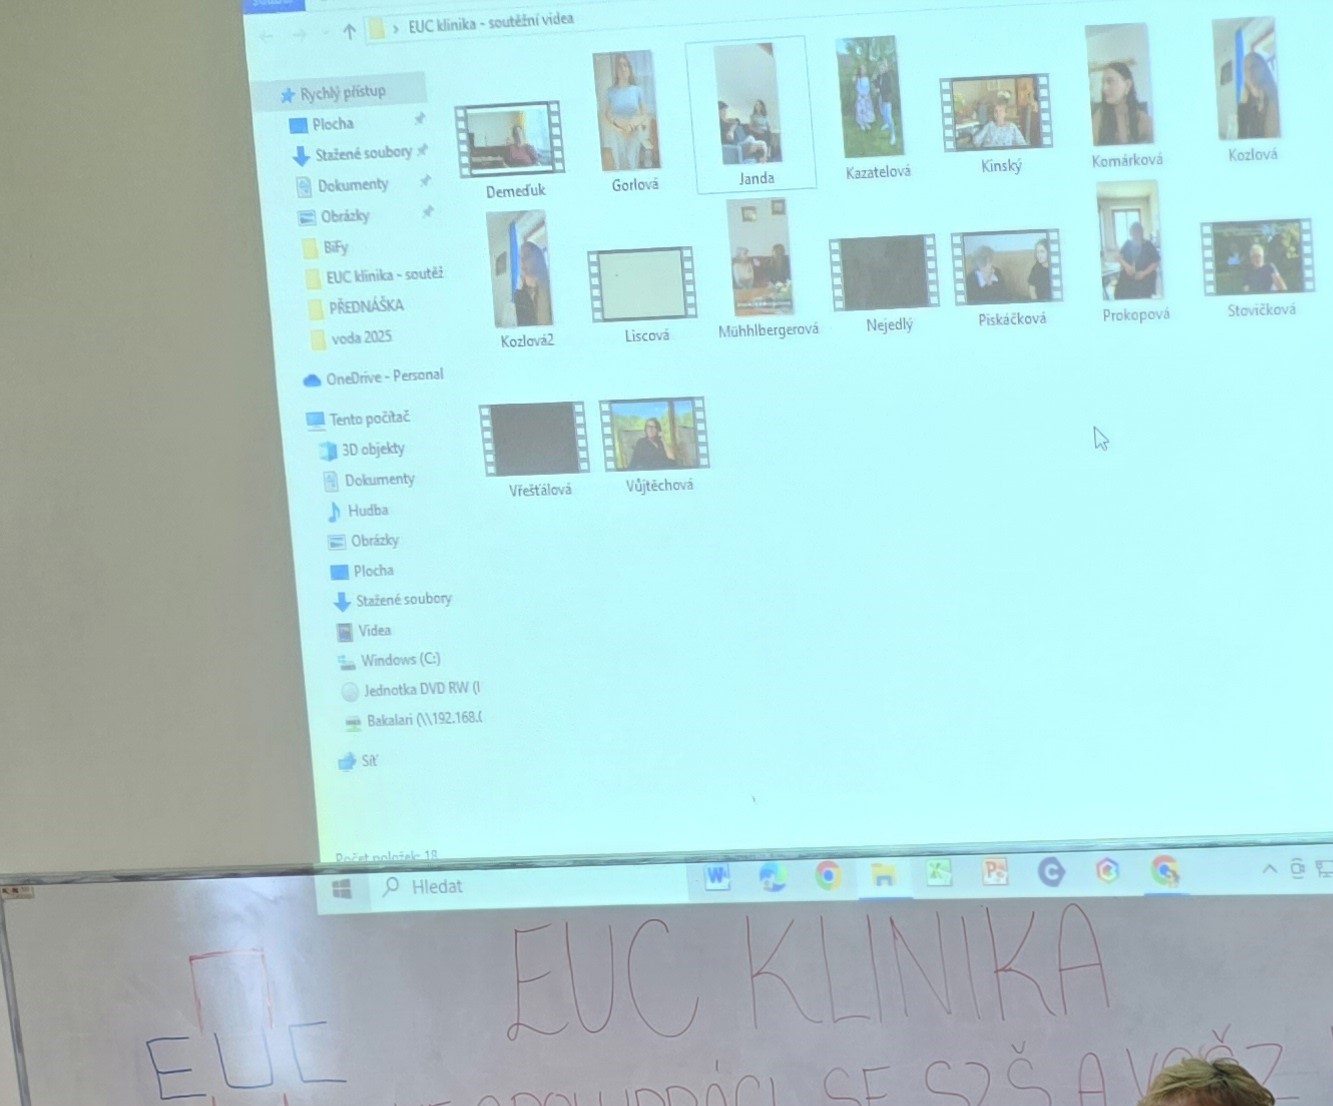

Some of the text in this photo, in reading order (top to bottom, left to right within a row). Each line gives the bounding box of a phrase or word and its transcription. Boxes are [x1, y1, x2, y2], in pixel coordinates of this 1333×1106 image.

[409, 19, 434, 34] EUC
[437, 18, 477, 33] klinika
[489, 13, 540, 29] soutěžní
[541, 12, 575, 27] videa
[301, 84, 386, 104] Rychlý přístup
[312, 117, 354, 131] Plocha
[316, 145, 413, 162] Stažené soubory
[1092, 151, 1163, 168] Komárková
[1228, 147, 1278, 162] Kozlová
[739, 171, 775, 186] Janda
[846, 164, 911, 180] Kazatelová
[318, 177, 389, 193] Dokumenty
[612, 177, 659, 192] Gorlová
[320, 209, 370, 225] Obrázky
[326, 271, 352, 284] EUC
[354, 269, 394, 283] klinika
[405, 266, 444, 280] soutěž
[329, 295, 405, 315] PŘEDNÁŠKA
[1102, 307, 1170, 324] Prokopová
[866, 317, 914, 335] Nejedlý
[331, 329, 393, 345] voda 2025
[501, 333, 555, 349] Kozlová2
[625, 328, 670, 343] Liscová
[326, 371, 382, 386] OneDrive
[393, 367, 445, 382] Personal
[330, 410, 411, 428] Tento počítač
[342, 441, 405, 458] 3D objekty
[345, 473, 415, 488] Dokumenty
[348, 503, 389, 518] Hudba
[351, 533, 400, 549] Obrázky
[354, 564, 395, 578] Plocha
[356, 592, 453, 608] Stažené soubory
[358, 624, 392, 637] Videa
[361, 652, 441, 667] Windows (C:)
[364, 683, 417, 697] Jednotka
[420, 682, 445, 695] DVD
[449, 681, 469, 694] RW
[412, 878, 464, 894] Hledat
[507, 903, 1110, 1041] EUC KLINIKA
[146, 1021, 347, 1100] EUC
